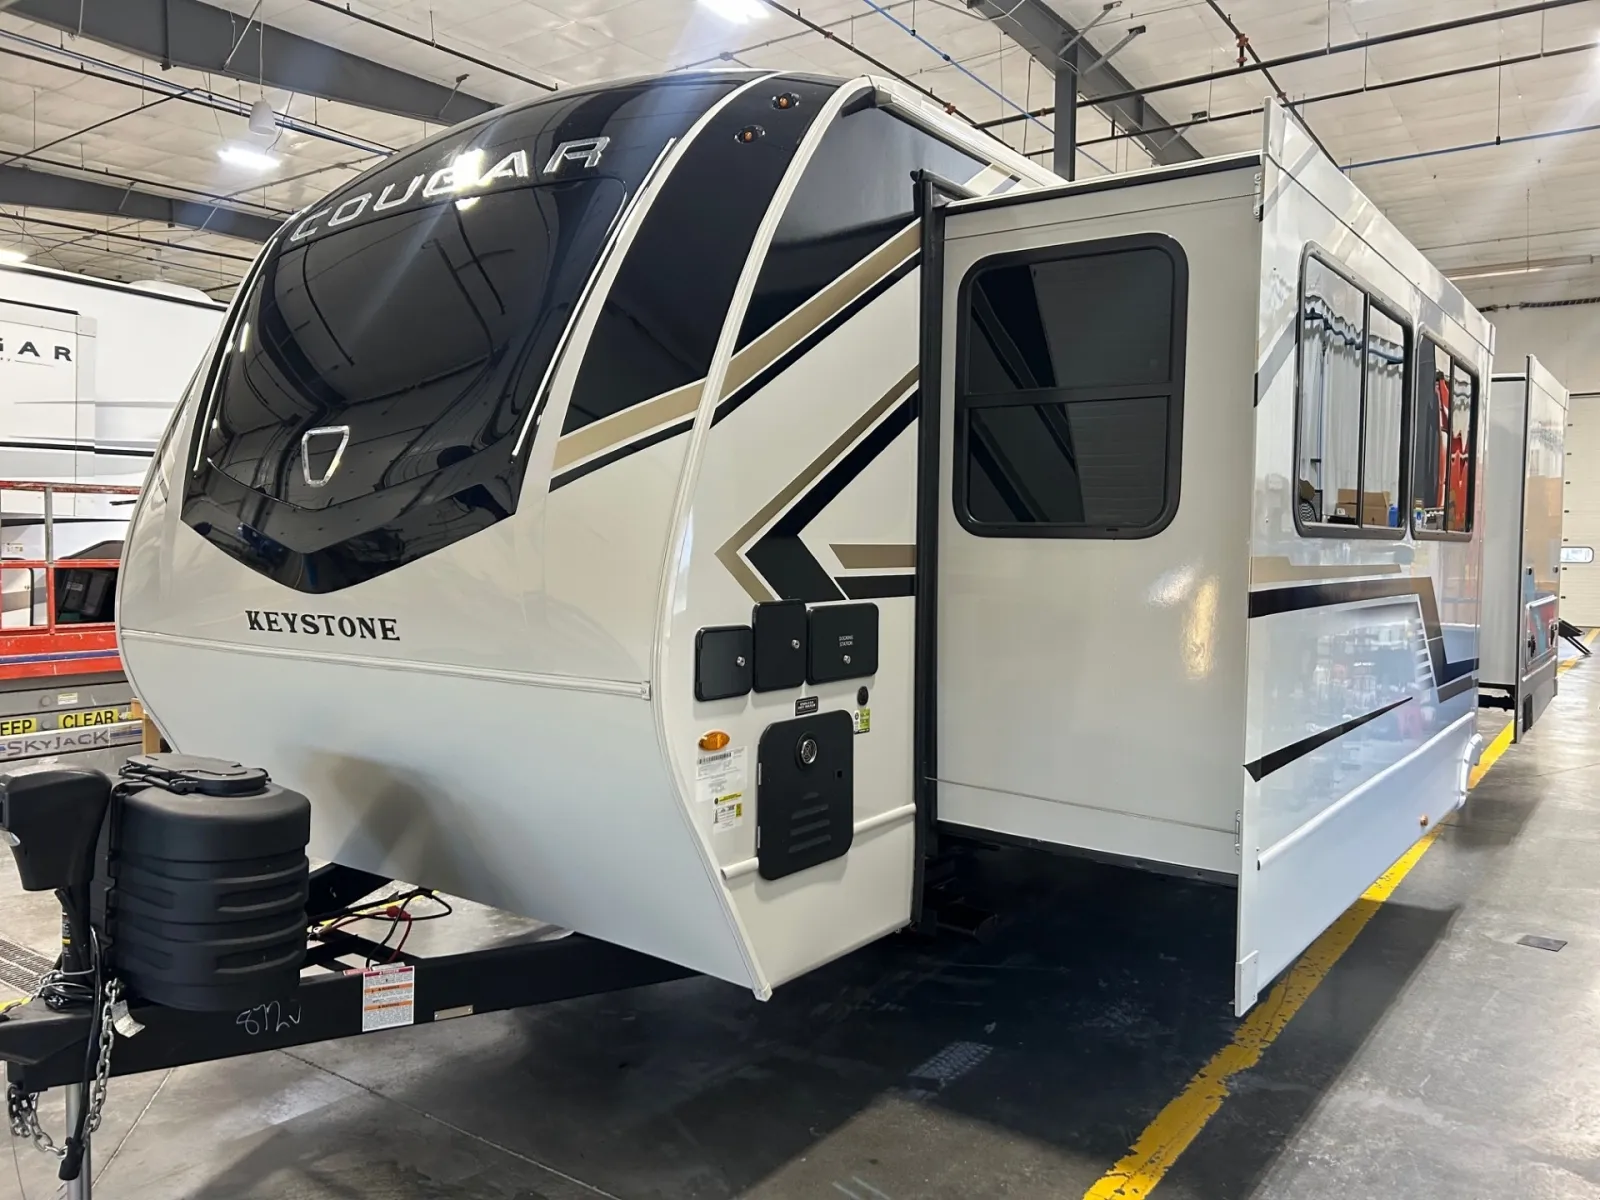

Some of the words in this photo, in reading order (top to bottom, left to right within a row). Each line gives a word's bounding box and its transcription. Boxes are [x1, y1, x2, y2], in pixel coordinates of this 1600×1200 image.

[290, 136, 610, 242] COUGAR
[0, 337, 73, 362] AR
[245, 610, 401, 641] KEYSTONE
[62, 710, 115, 729] CLEAR
[7, 728, 110, 757] SKYJACK
